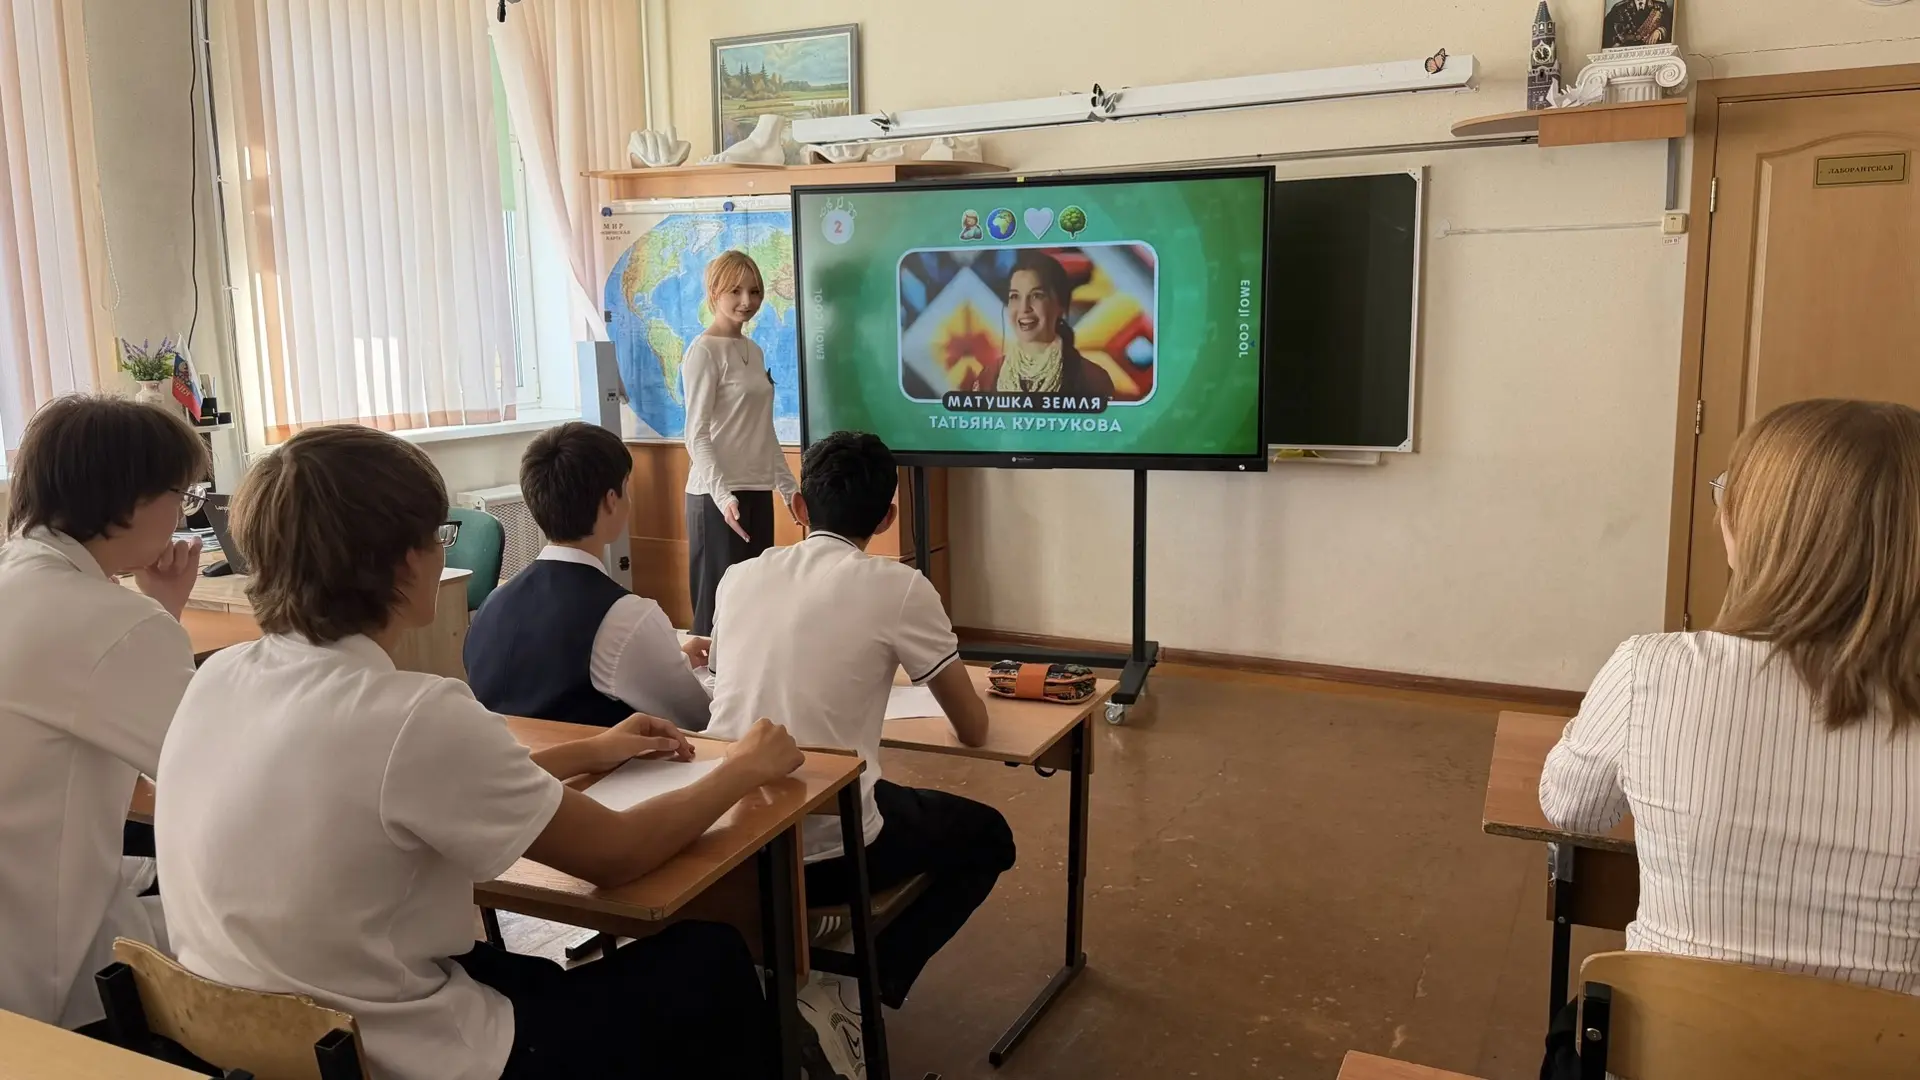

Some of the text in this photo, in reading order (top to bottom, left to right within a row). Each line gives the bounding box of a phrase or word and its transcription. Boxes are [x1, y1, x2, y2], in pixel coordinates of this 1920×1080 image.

[1828, 165, 1894, 174] ЛАБОРАНТСКАЯ
[834, 220, 843, 233] 2
[814, 288, 825, 360] EMOJI COOL
[1238, 279, 1250, 358] EMOJI COOL
[947, 395, 1101, 410] МАТУШКА ЗЕМЛЯ
[929, 415, 1122, 432] ТАТЬЯНА КУРТУКОВА
